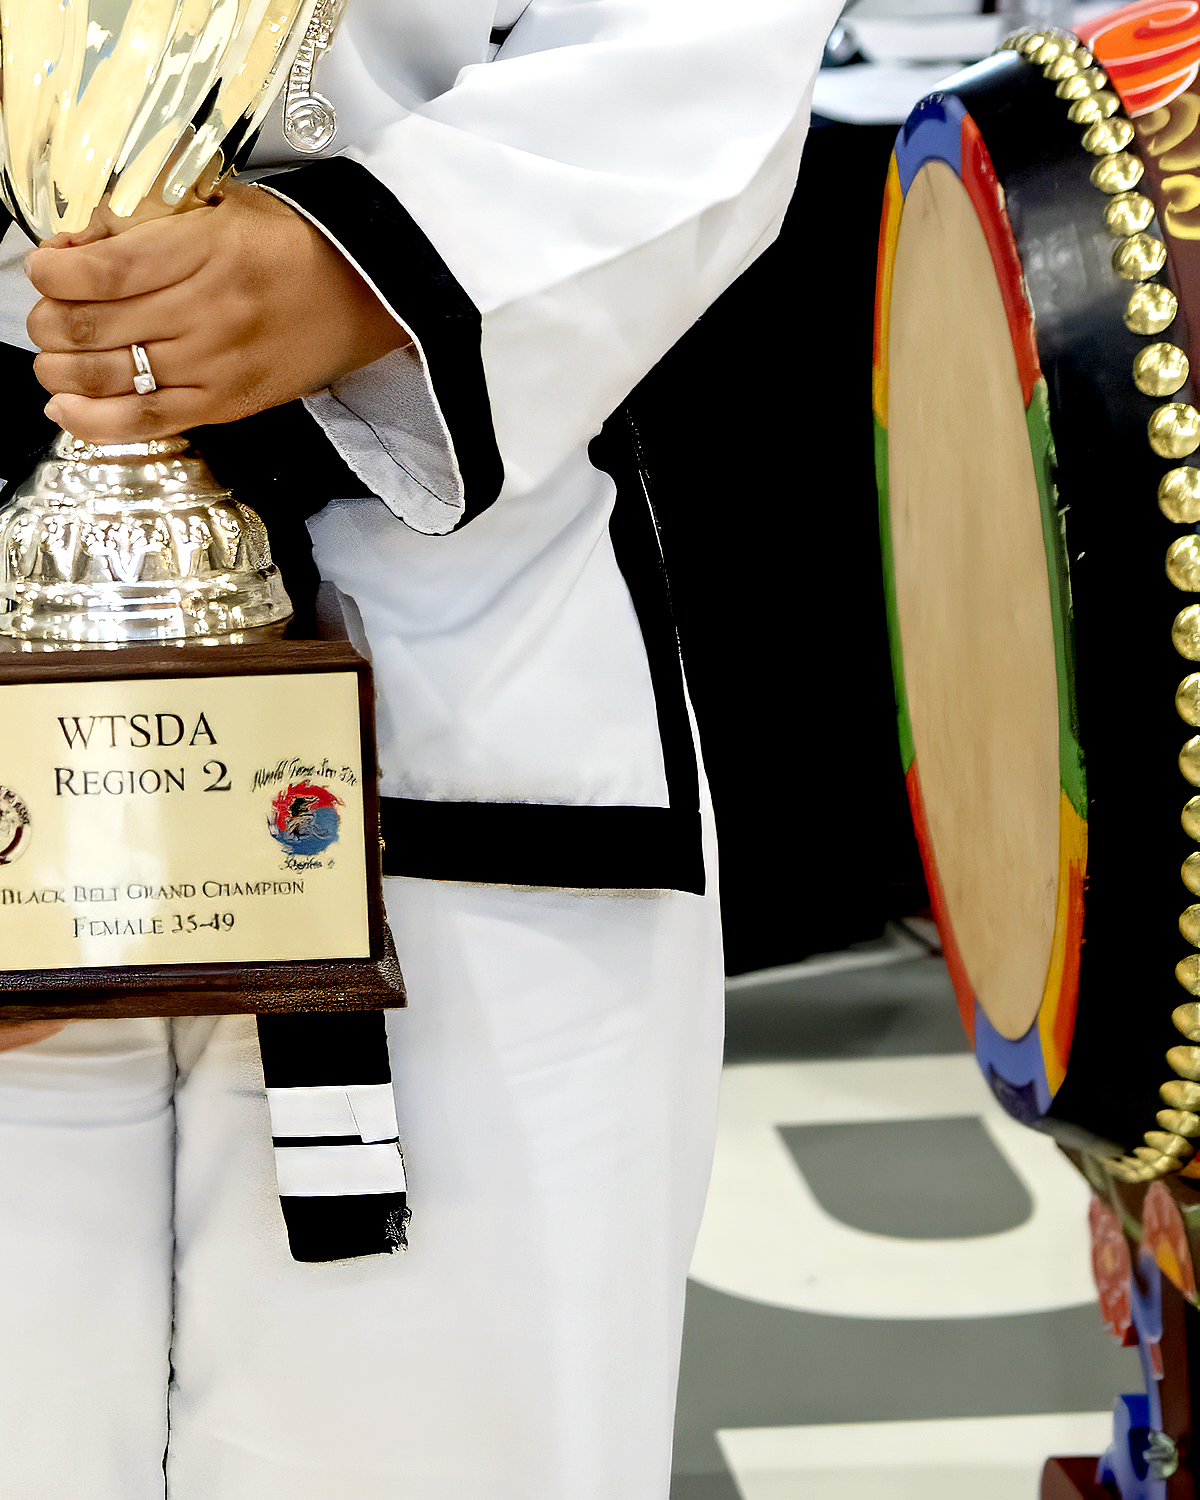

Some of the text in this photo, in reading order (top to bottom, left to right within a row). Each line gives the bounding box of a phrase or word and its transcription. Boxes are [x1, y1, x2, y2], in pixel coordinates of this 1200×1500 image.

[56, 711, 218, 750] WTSDA
[53, 759, 232, 796] REGION 2
[202, 879, 305, 898] CHAMPION
